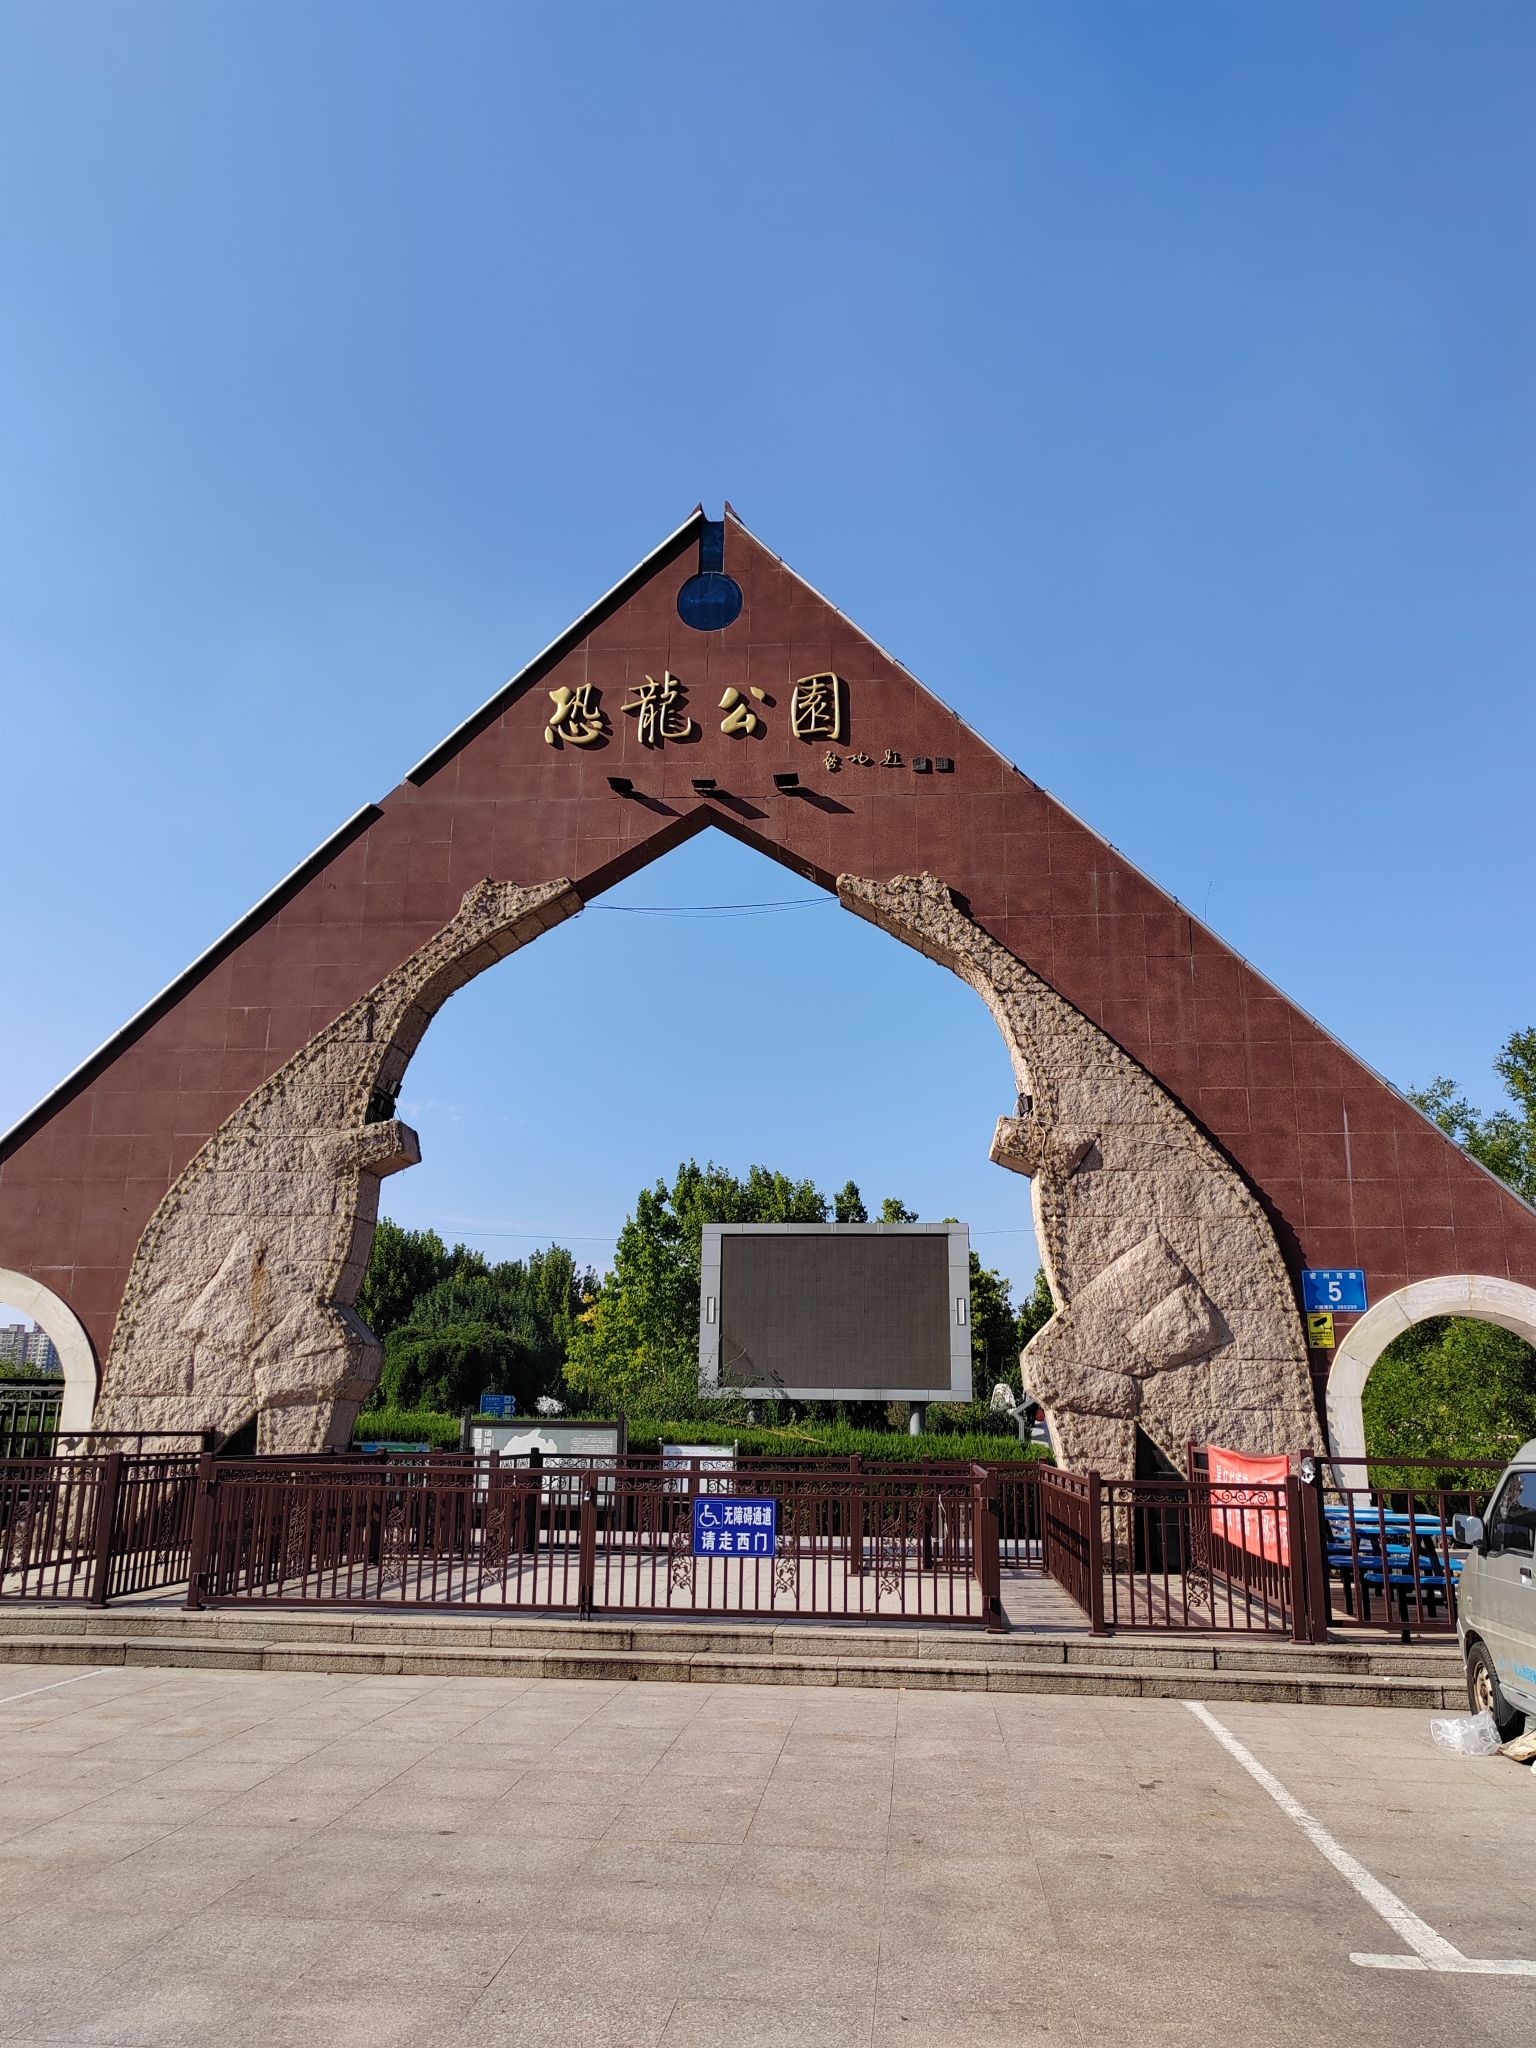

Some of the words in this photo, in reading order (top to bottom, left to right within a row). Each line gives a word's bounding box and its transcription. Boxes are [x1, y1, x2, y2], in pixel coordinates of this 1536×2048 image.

[1328, 1281, 1342, 1302] 5
[723, 1506, 772, 1526] 无障碍通道
[701, 1530, 768, 1552] 请走西门
